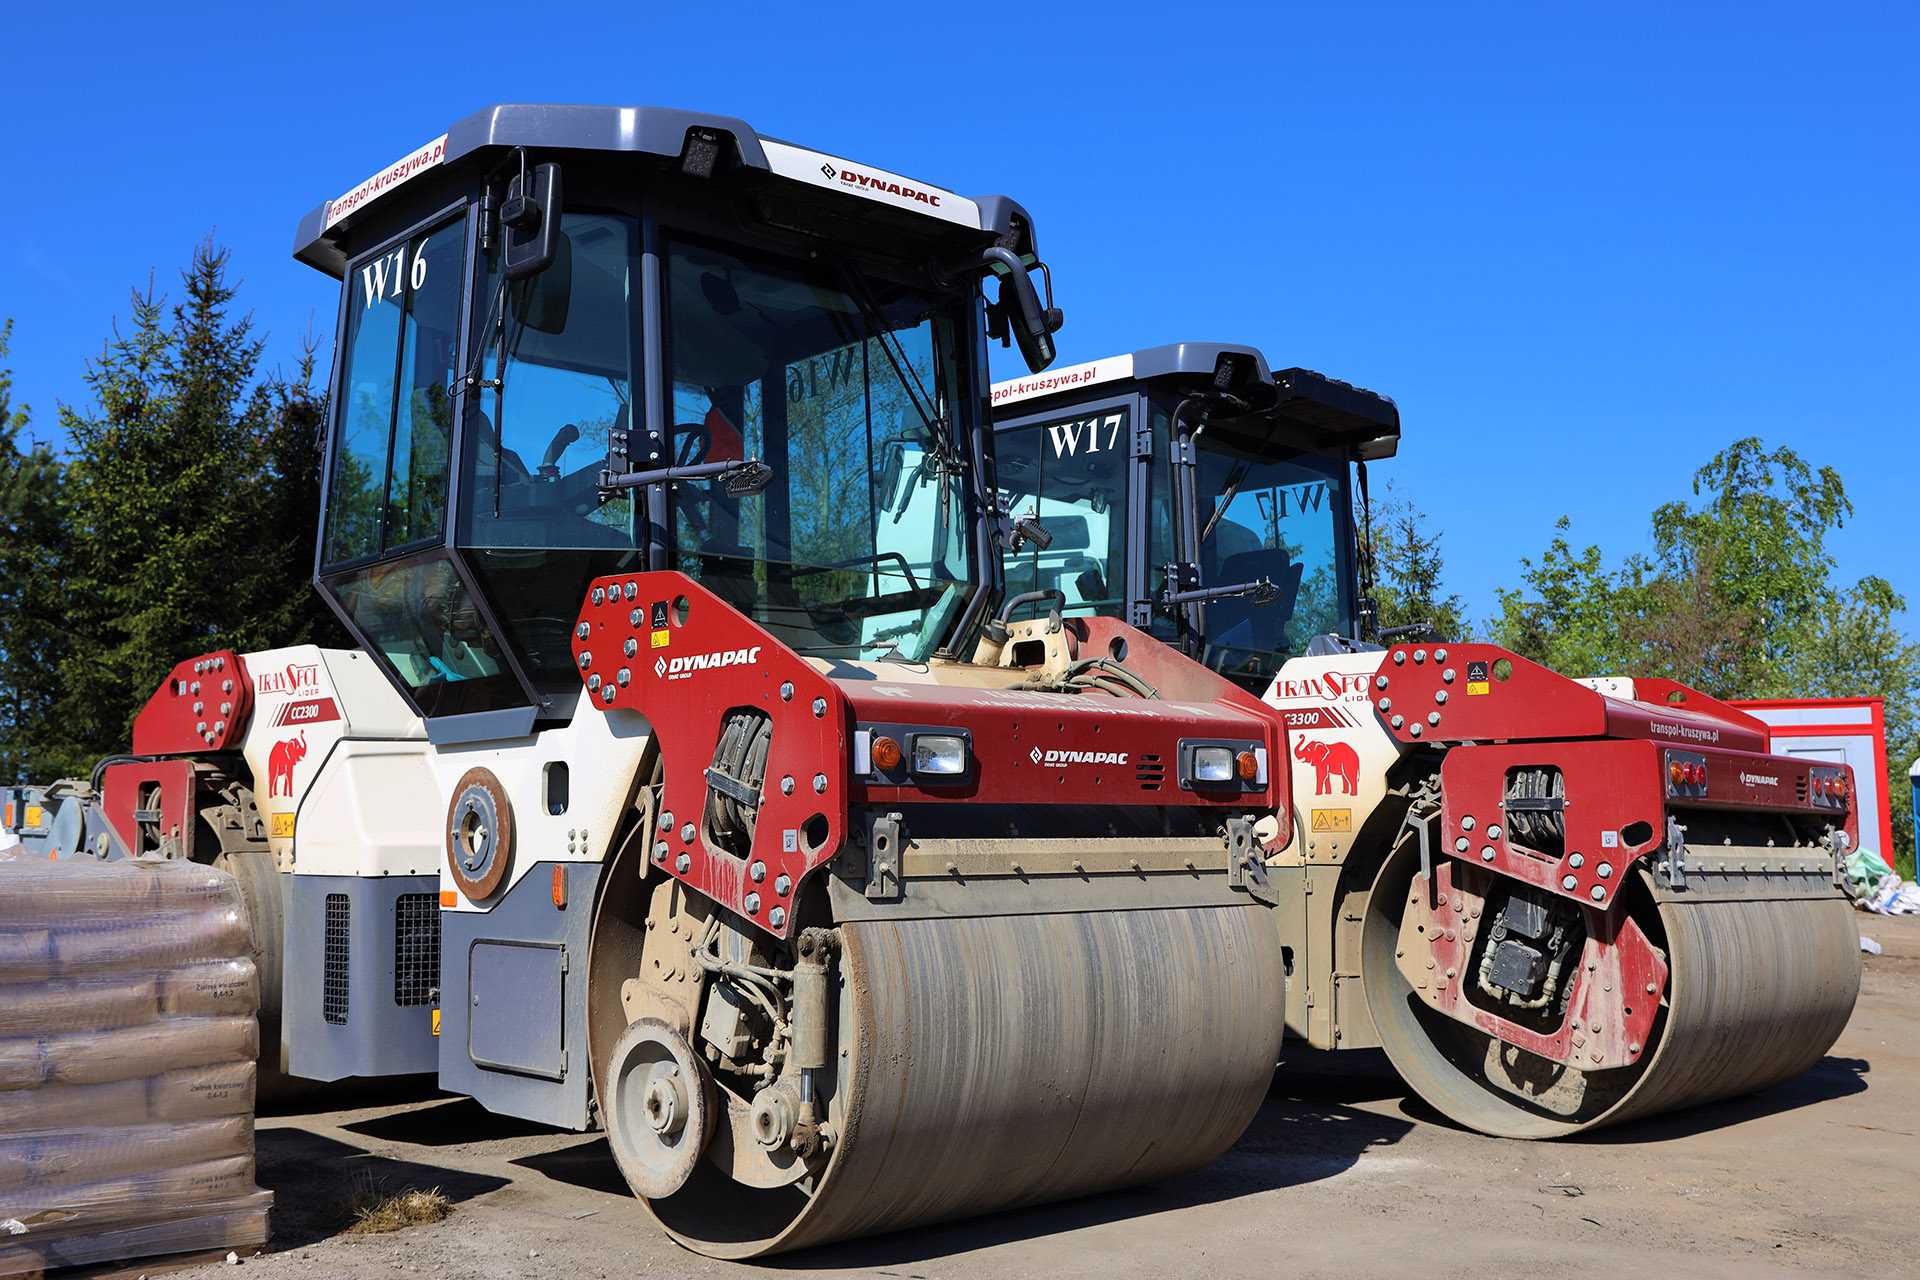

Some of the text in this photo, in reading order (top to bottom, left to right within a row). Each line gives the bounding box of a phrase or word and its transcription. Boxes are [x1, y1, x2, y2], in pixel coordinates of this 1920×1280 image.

[327, 137, 448, 221] transpol-kruszywa.pl
[840, 170, 941, 207] DYNAPAC
[362, 237, 430, 310] W16
[1047, 413, 1122, 460] W17
[668, 646, 761, 673] DYNAPAC
[258, 664, 319, 695] TRANSPOL
[291, 704, 319, 720] CC2300
[1650, 720, 1719, 743] transpol-kruszywa.pl
[1044, 750, 1129, 765] DYNAPAC
[1746, 774, 1779, 786] DYNAPAC
